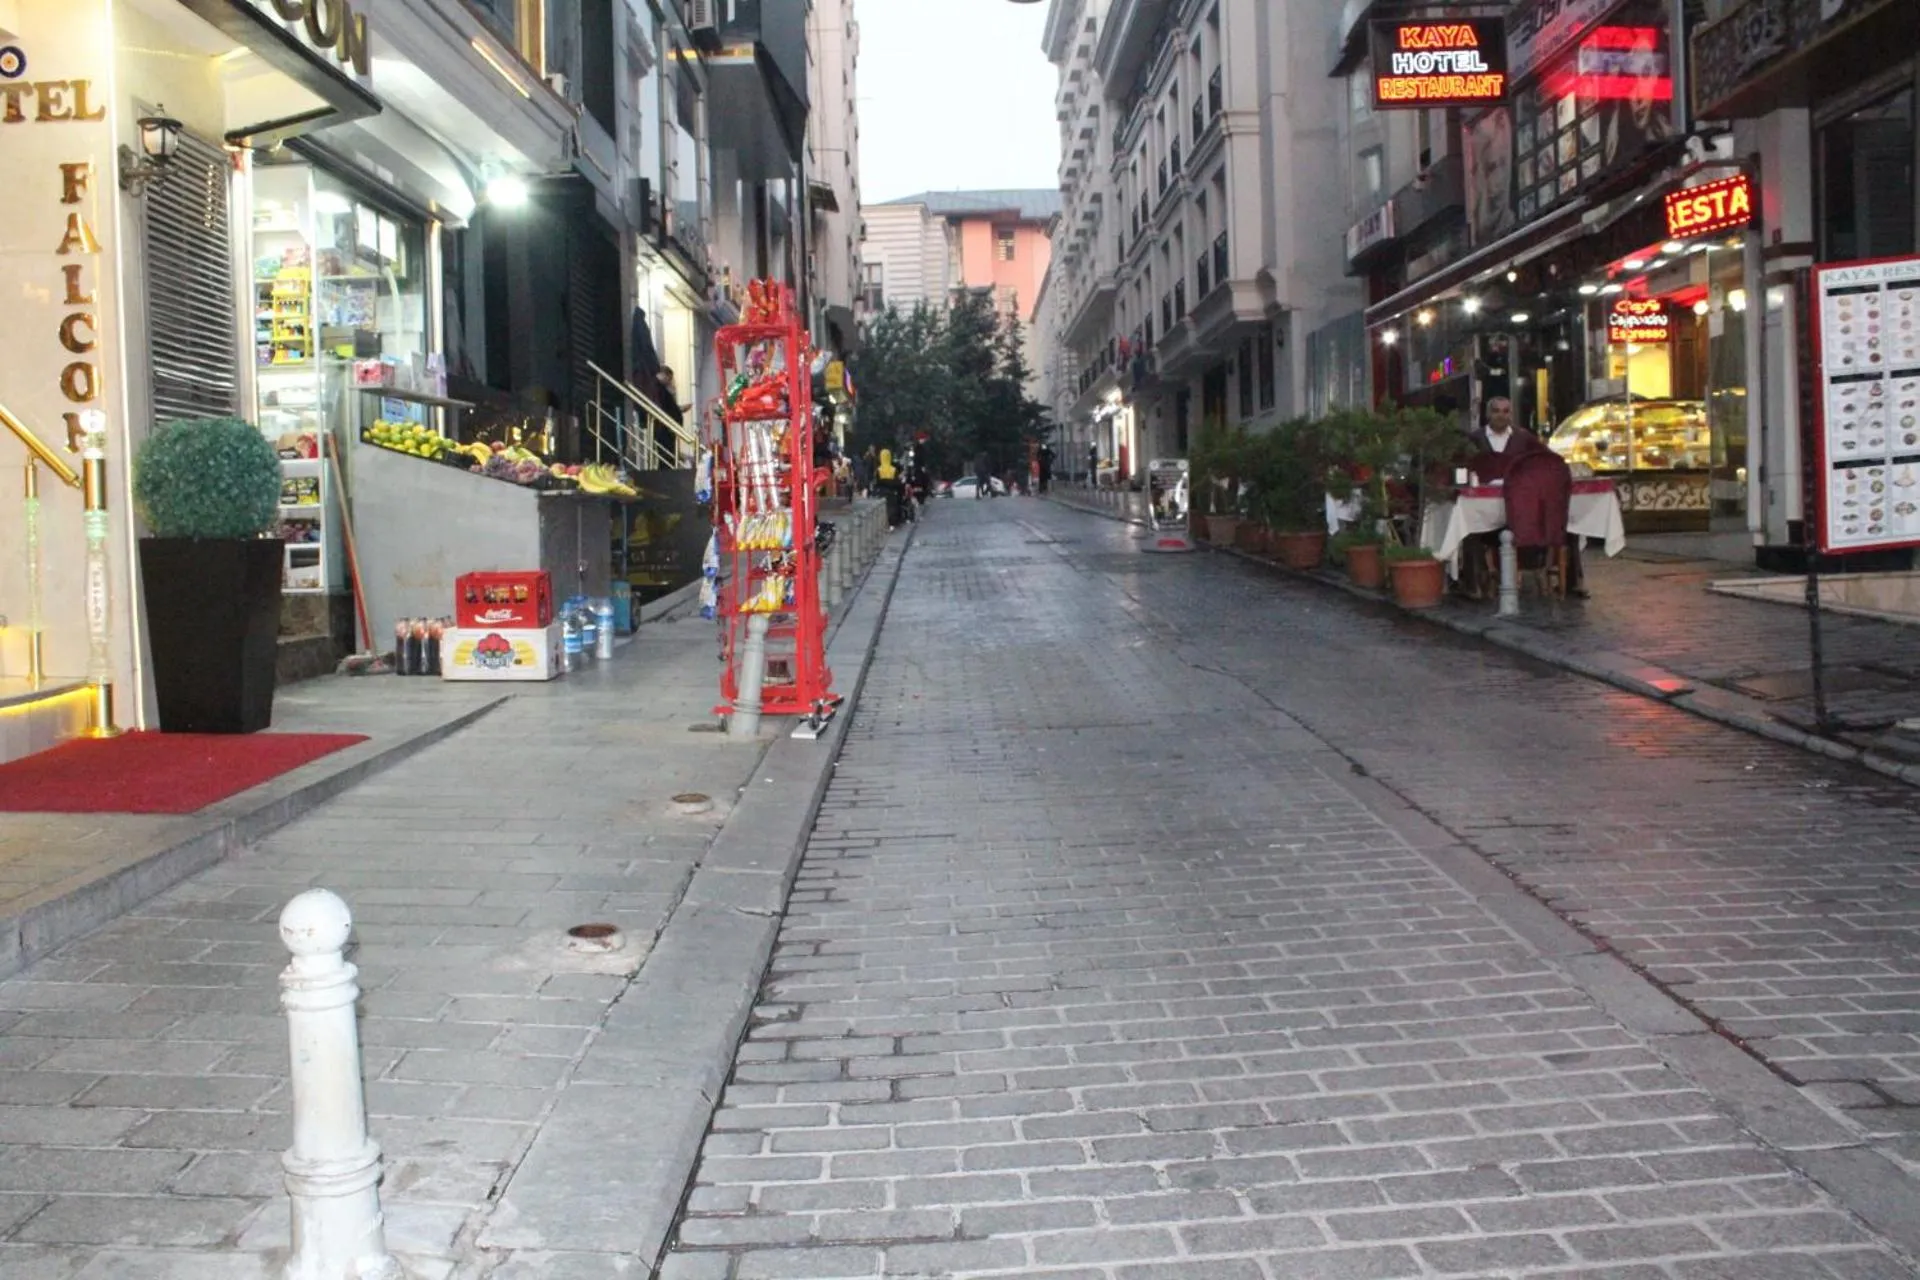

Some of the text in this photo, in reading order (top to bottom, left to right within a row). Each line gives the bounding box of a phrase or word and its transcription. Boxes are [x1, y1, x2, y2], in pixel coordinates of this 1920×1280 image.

[1399, 25, 1478, 48] KAYA
[1392, 50, 1488, 74] HOTEL
[1379, 74, 1503, 99] RESTAURANT
[1667, 186, 1749, 230] ESTA
[1824, 268, 1876, 282] KAYA
